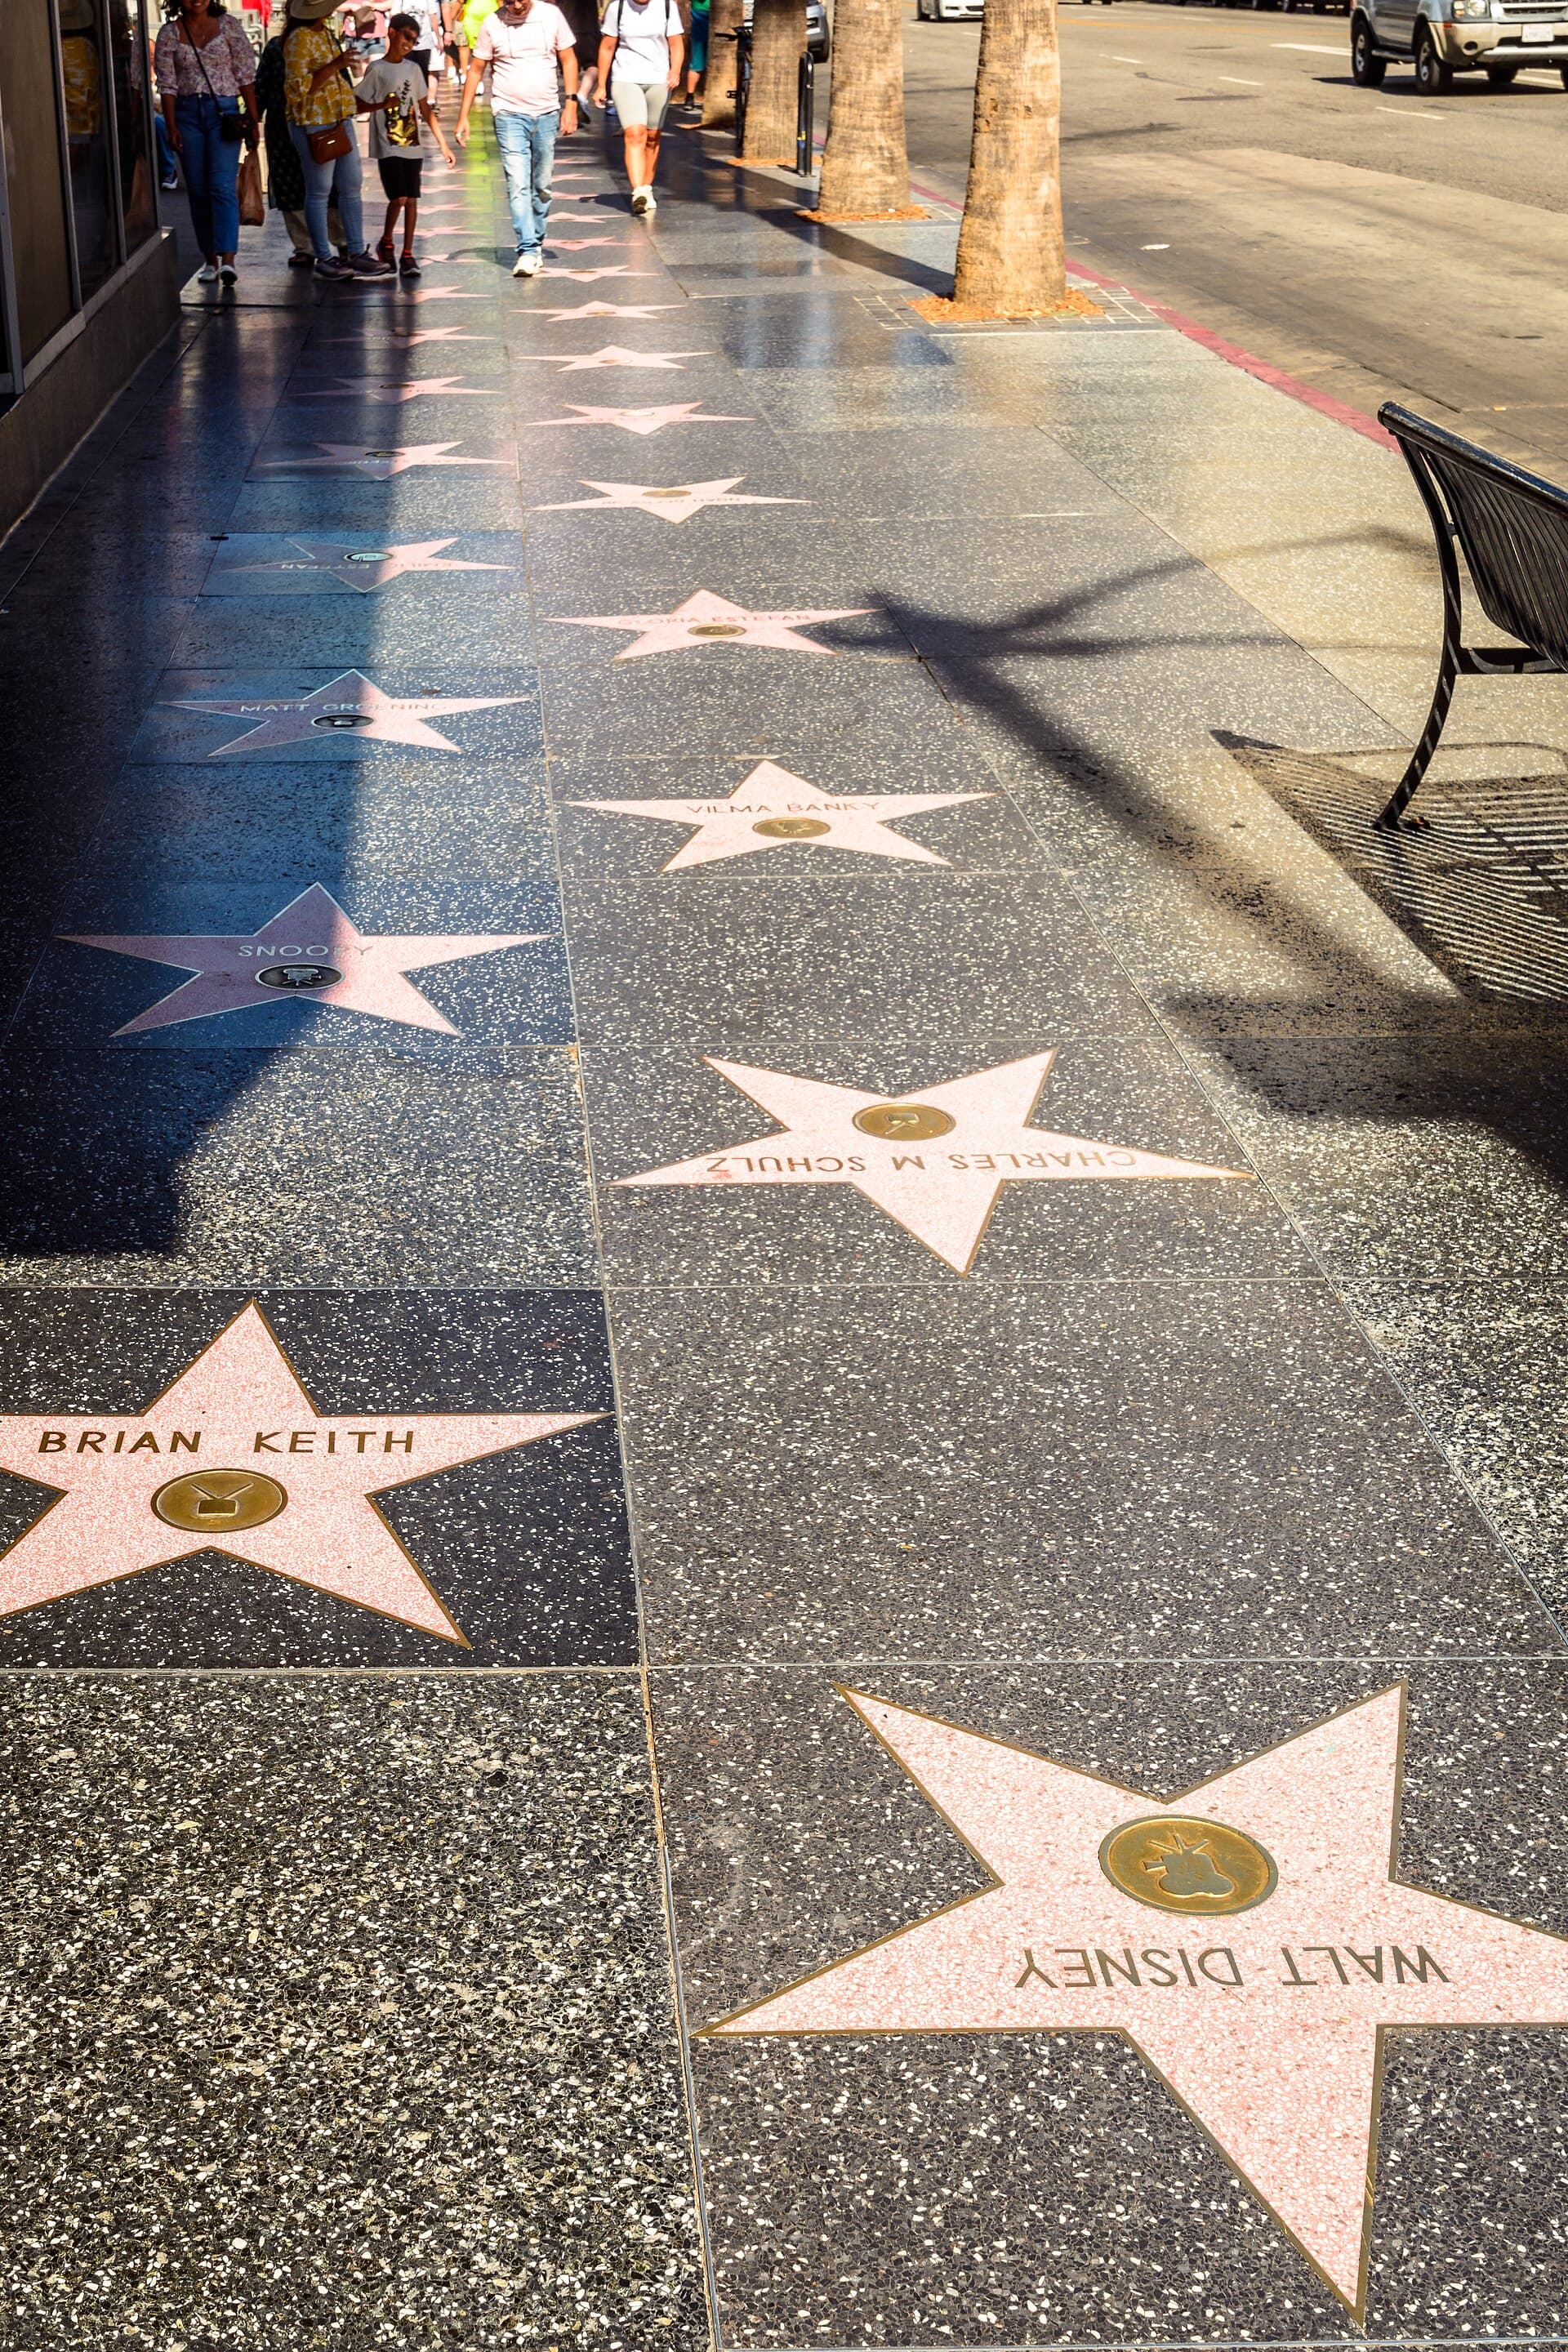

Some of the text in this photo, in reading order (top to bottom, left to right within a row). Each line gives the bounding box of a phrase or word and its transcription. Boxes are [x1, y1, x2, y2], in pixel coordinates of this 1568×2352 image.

[239, 703, 310, 713] MATT
[687, 801, 880, 814] VILMA BANKY
[238, 945, 373, 957] SNOOPY
[706, 1151, 1138, 1173] CHARLES M SCHULZ
[38, 1430, 415, 1454] BRIAN KEITH
[1014, 1944, 1451, 1989] WALT DISNEY
